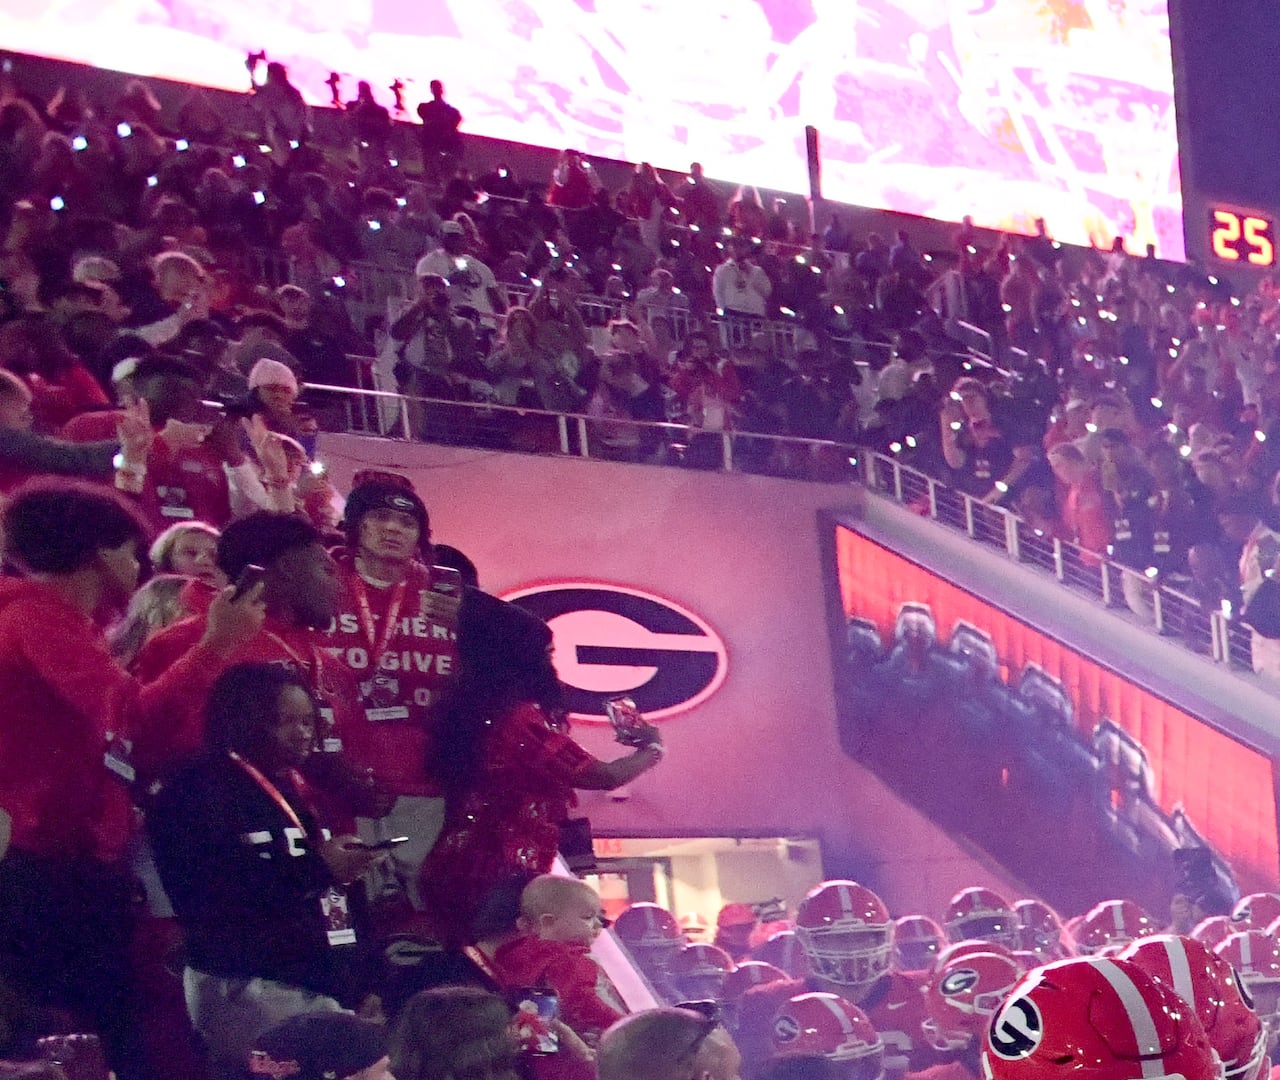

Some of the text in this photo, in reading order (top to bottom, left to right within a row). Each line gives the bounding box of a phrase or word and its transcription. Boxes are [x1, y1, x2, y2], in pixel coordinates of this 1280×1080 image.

[1213, 210, 1274, 267] 25
[393, 614, 457, 641] HER
[381, 650, 453, 676] GIVE
